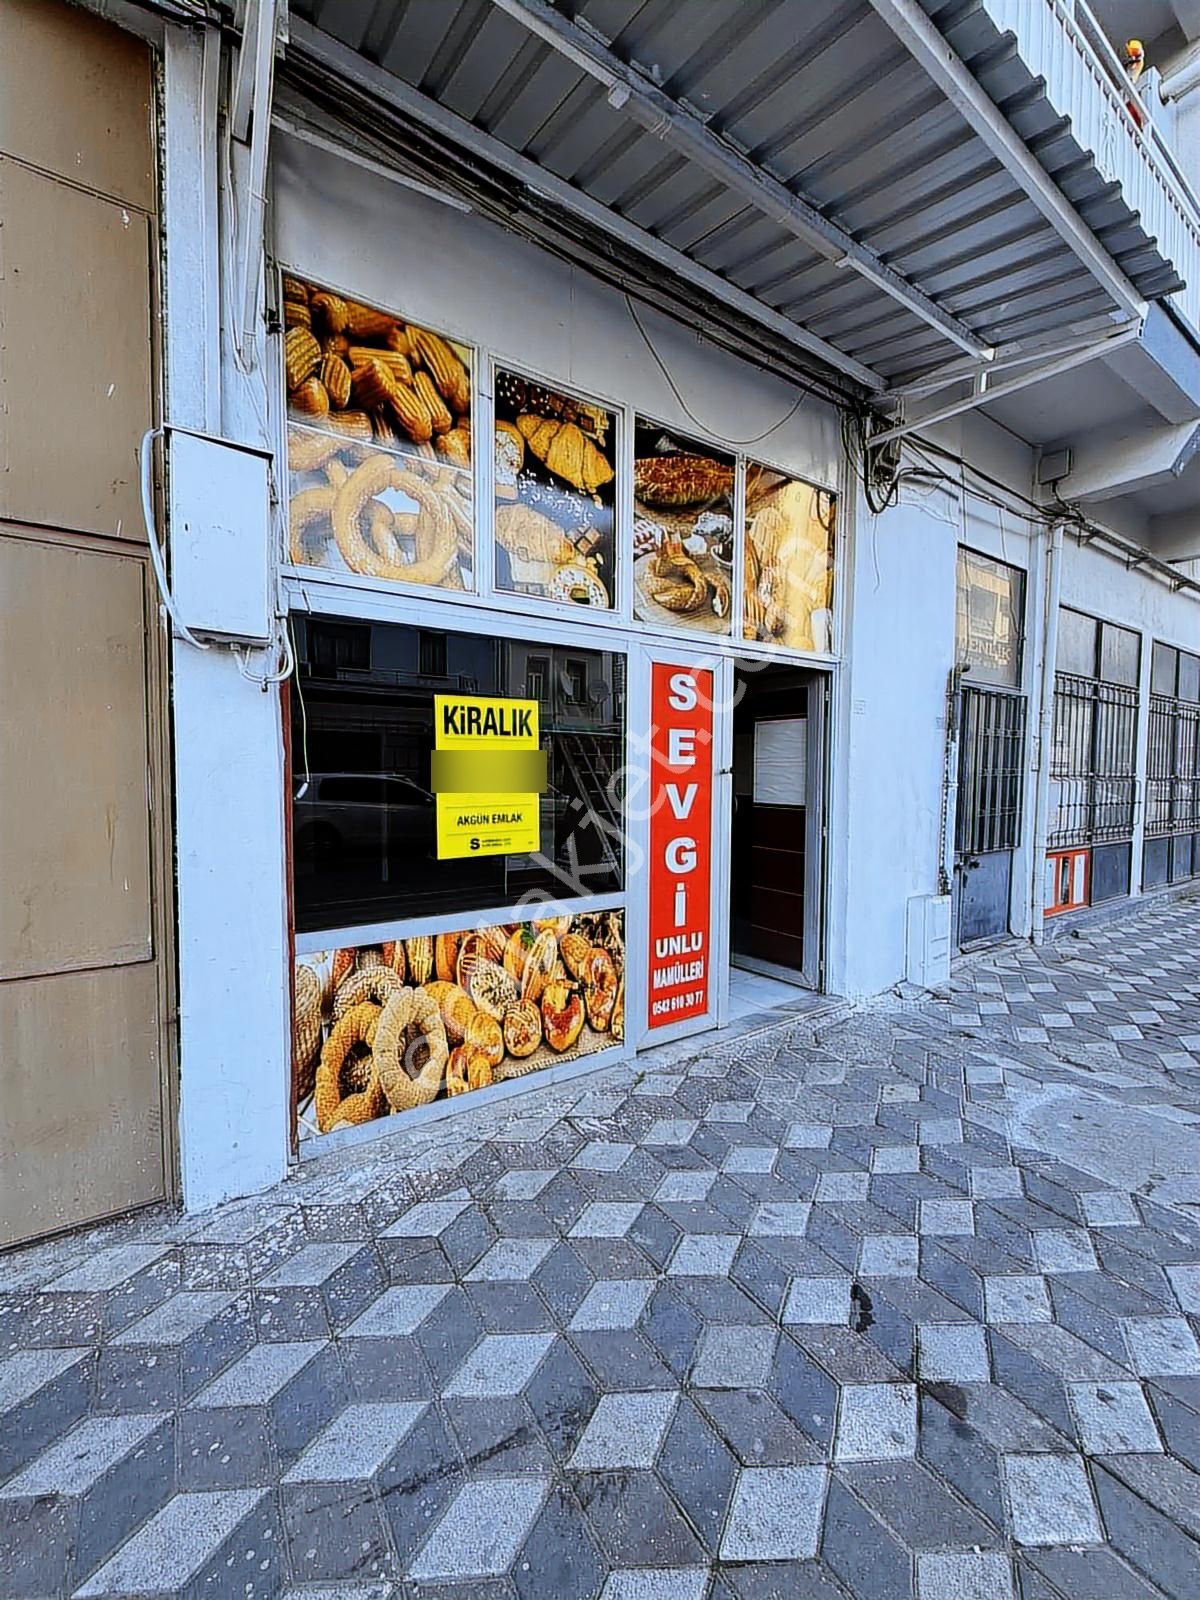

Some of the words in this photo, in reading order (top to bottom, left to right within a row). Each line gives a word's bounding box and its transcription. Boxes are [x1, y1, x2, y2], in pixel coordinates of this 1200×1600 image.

[664, 673, 698, 928] SEVGİ
[457, 814, 489, 826] AKGÜN
[492, 812, 523, 825] EMLAK
[470, 838, 480, 850] S
[655, 931, 703, 958] UNLU
[653, 955, 704, 989] MAMÜLLERİ
[652, 998, 670, 1015] 0542
[695, 990, 704, 1004] 77
